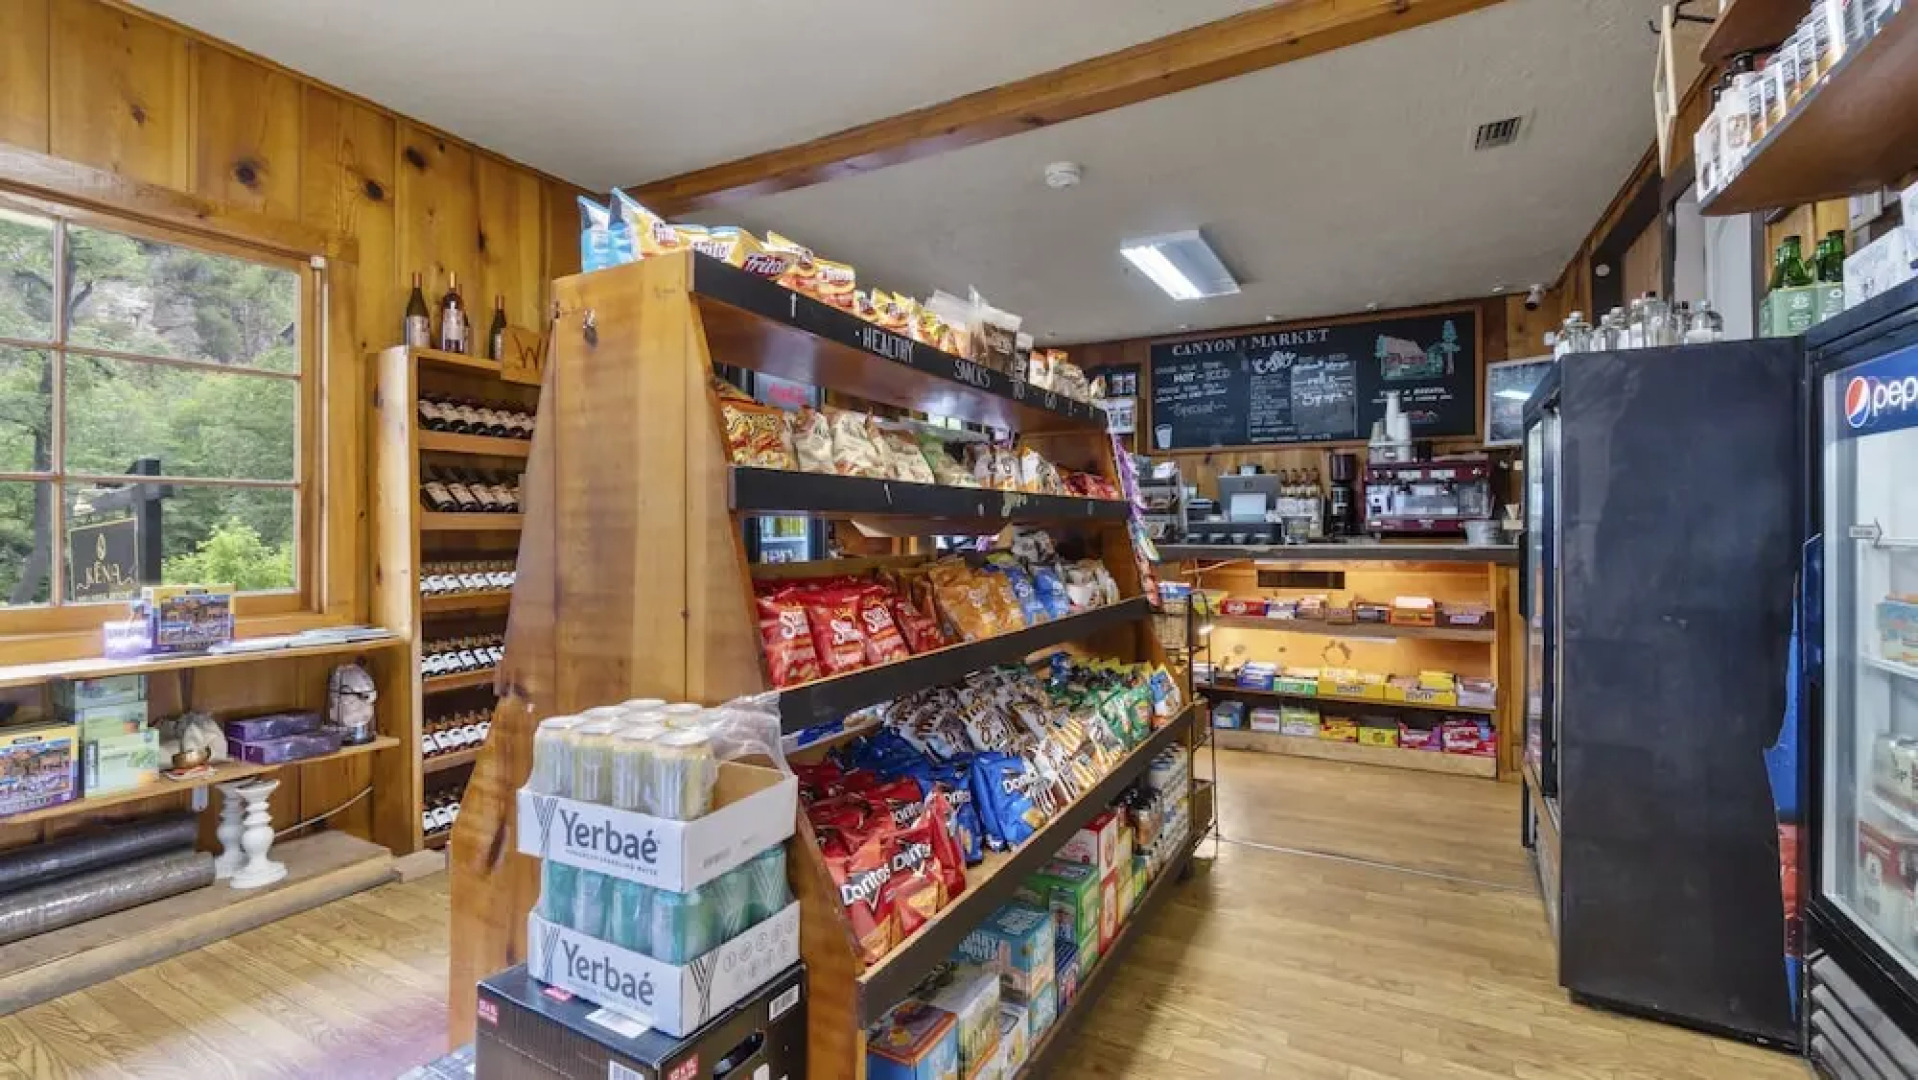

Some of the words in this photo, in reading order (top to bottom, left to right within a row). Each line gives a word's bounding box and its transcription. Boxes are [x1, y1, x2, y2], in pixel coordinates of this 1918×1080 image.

[862, 326, 915, 363] HEALTHY
[1171, 339, 1236, 356] CANYON
[1251, 328, 1330, 349] MARKET
[1873, 375, 1918, 416] pep
[559, 808, 659, 864] Yerbaé
[841, 863, 891, 906] Doritos
[561, 939, 654, 1006] Yerbaé
